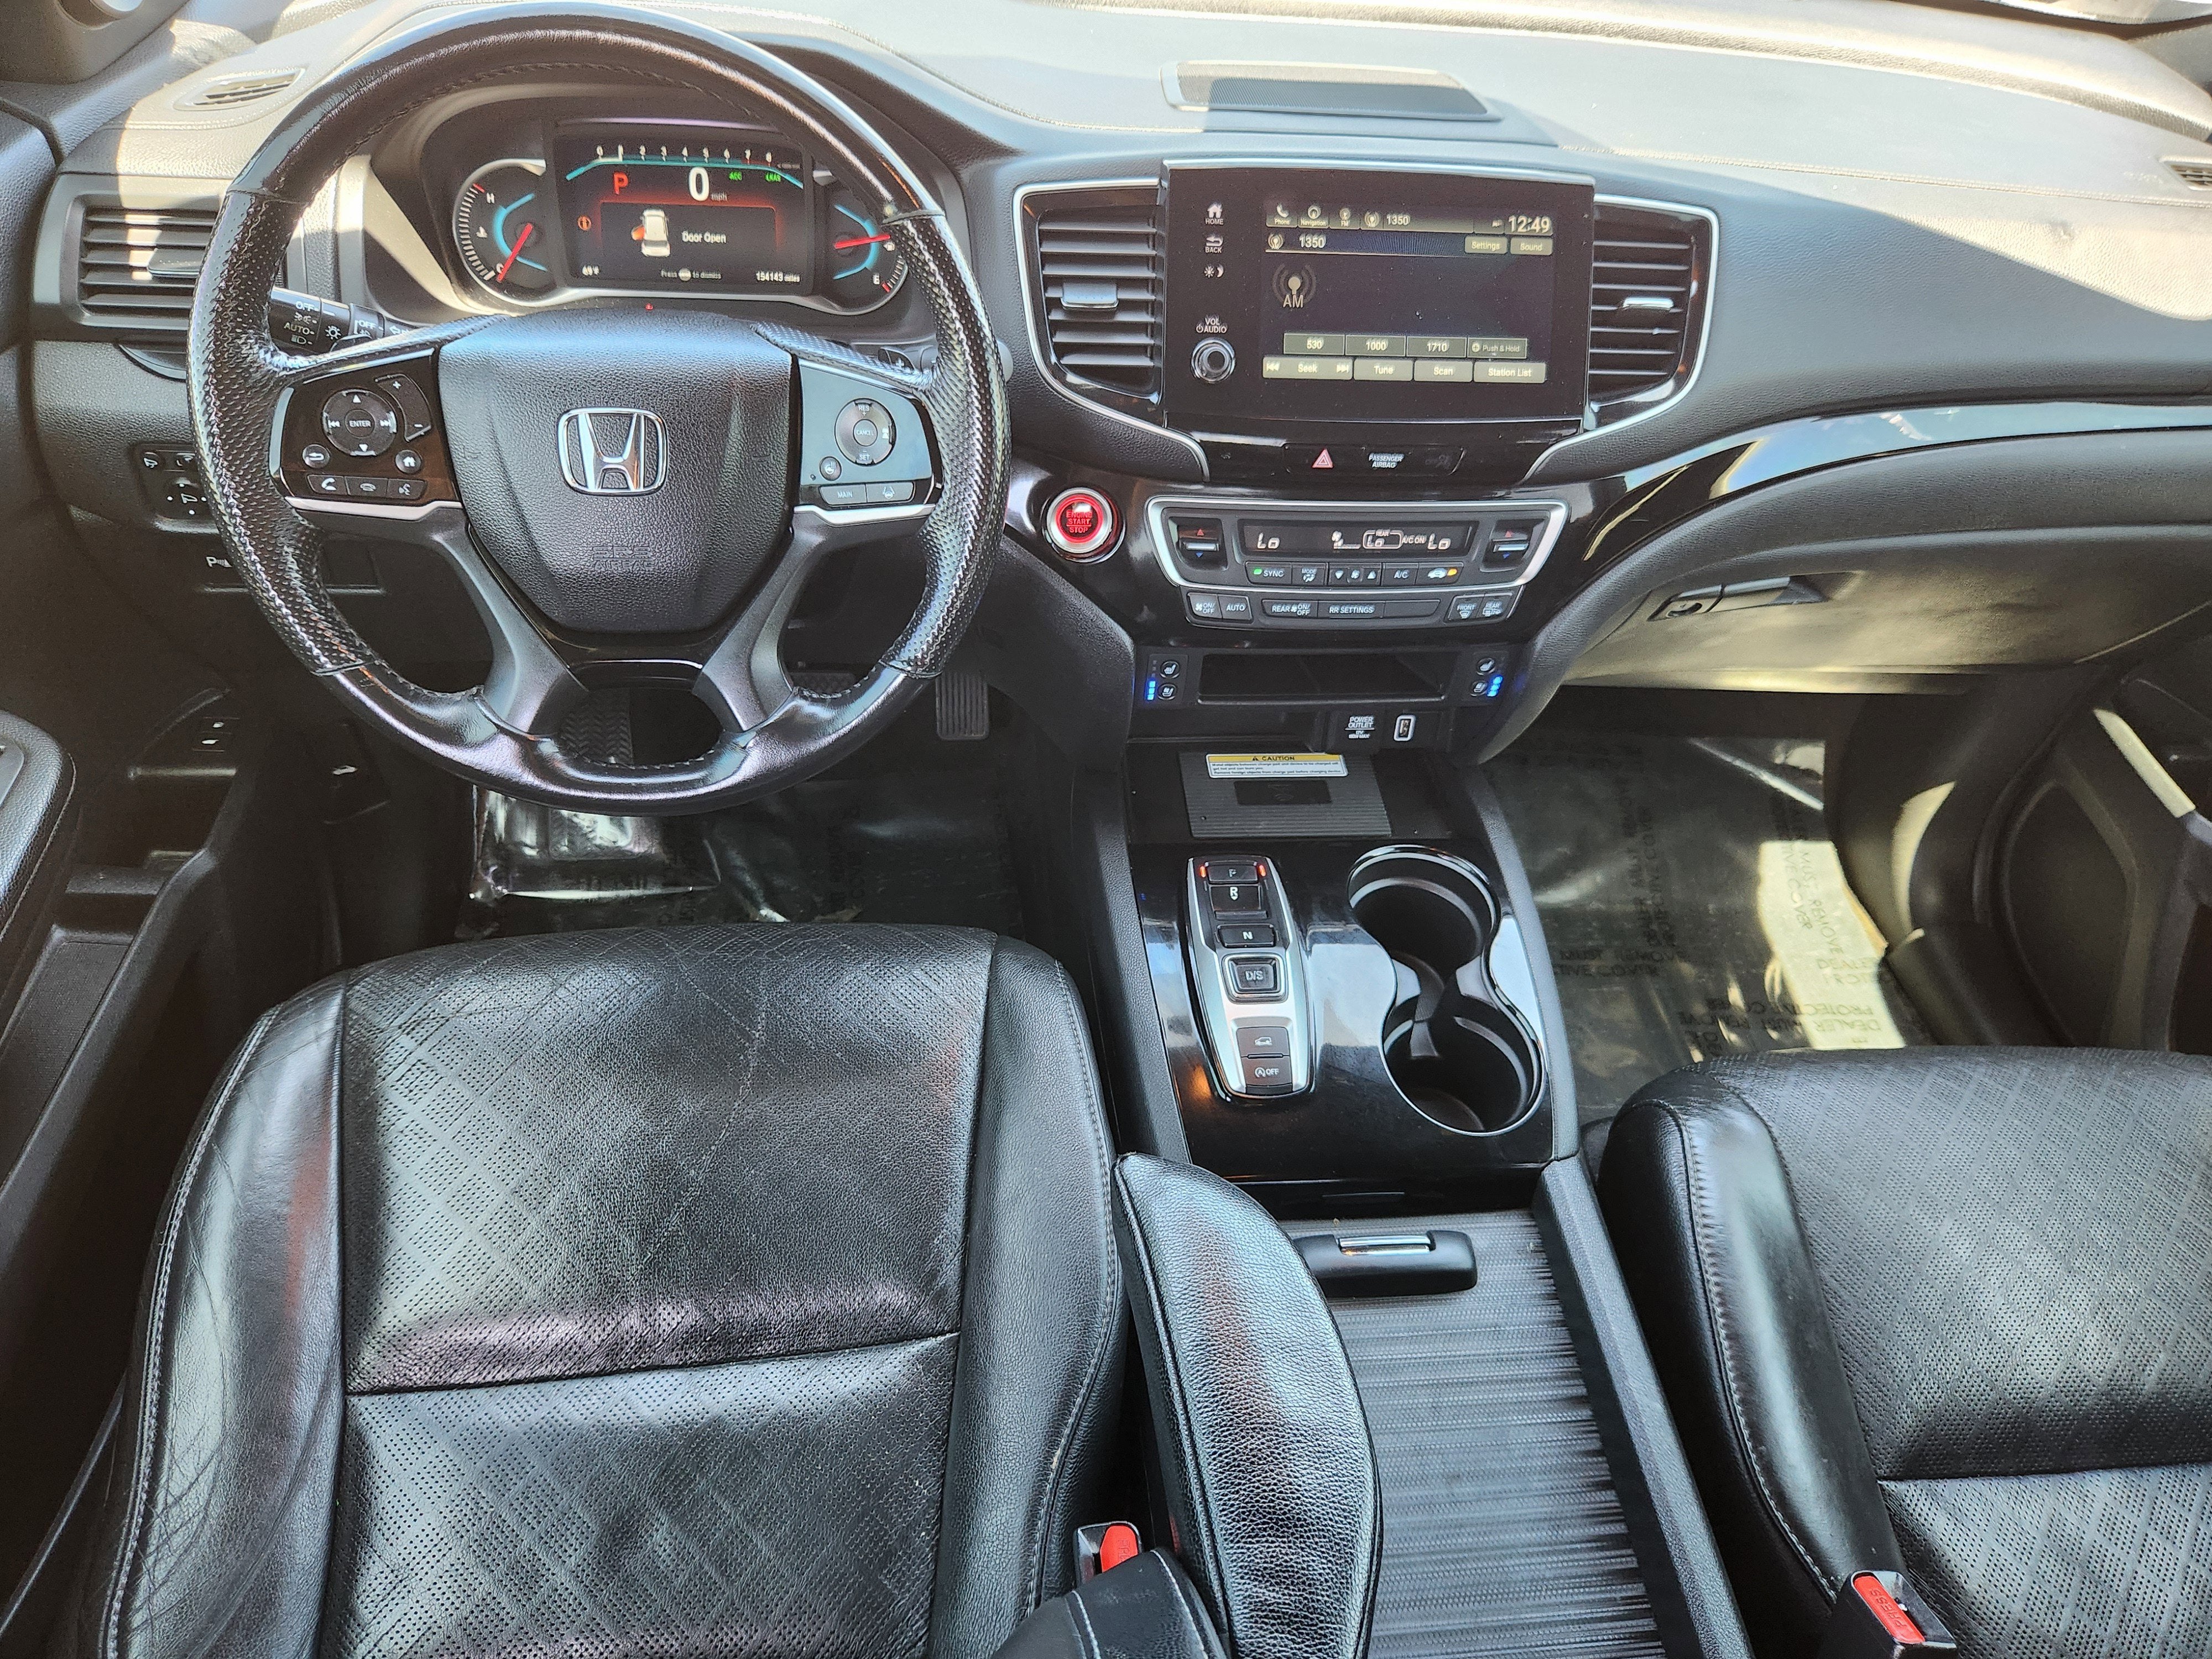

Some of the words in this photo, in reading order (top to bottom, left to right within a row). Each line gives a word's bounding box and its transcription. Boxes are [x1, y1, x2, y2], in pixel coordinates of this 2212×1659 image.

[614, 172, 628, 195] P
[688, 167, 709, 202] 0
[711, 192, 727, 202] mph
[1386, 214, 1410, 226] 1350
[1509, 215, 1550, 233] 12:49
[682, 231, 702, 243] Door
[704, 232, 727, 244] Open
[1300, 234, 1326, 248] 1350
[1472, 241, 1500, 251] Settings
[1520, 242, 1543, 252] Sound
[296, 301, 315, 311] OFF
[1283, 294, 1303, 308] AM
[284, 322, 310, 335] AUTO
[359, 320, 377, 330] OFF
[1204, 325, 1227, 333] AUDIO
[1307, 339, 1323, 349] 530
[1366, 340, 1387, 351] 1000
[1427, 341, 1448, 352] 1710
[1482, 345, 1498, 353] Push
[1298, 363, 1318, 373] Seek
[1374, 365, 1394, 375] Tune
[1433, 366, 1453, 376] Scan
[1488, 368, 1515, 377] Station
[1517, 369, 1532, 378] List
[1066, 509, 1093, 518] ENGINE
[1264, 569, 1284, 577] SYNC
[1394, 570, 1409, 578] A/C
[1340, 605, 1375, 614] SETTINGS
[1229, 869, 1237, 877] P
[1230, 886, 1239, 896] R
[1243, 931, 1253, 940] N
[1245, 970, 1264, 981] D/S
[1869, 1588, 1908, 1629] PRESS
